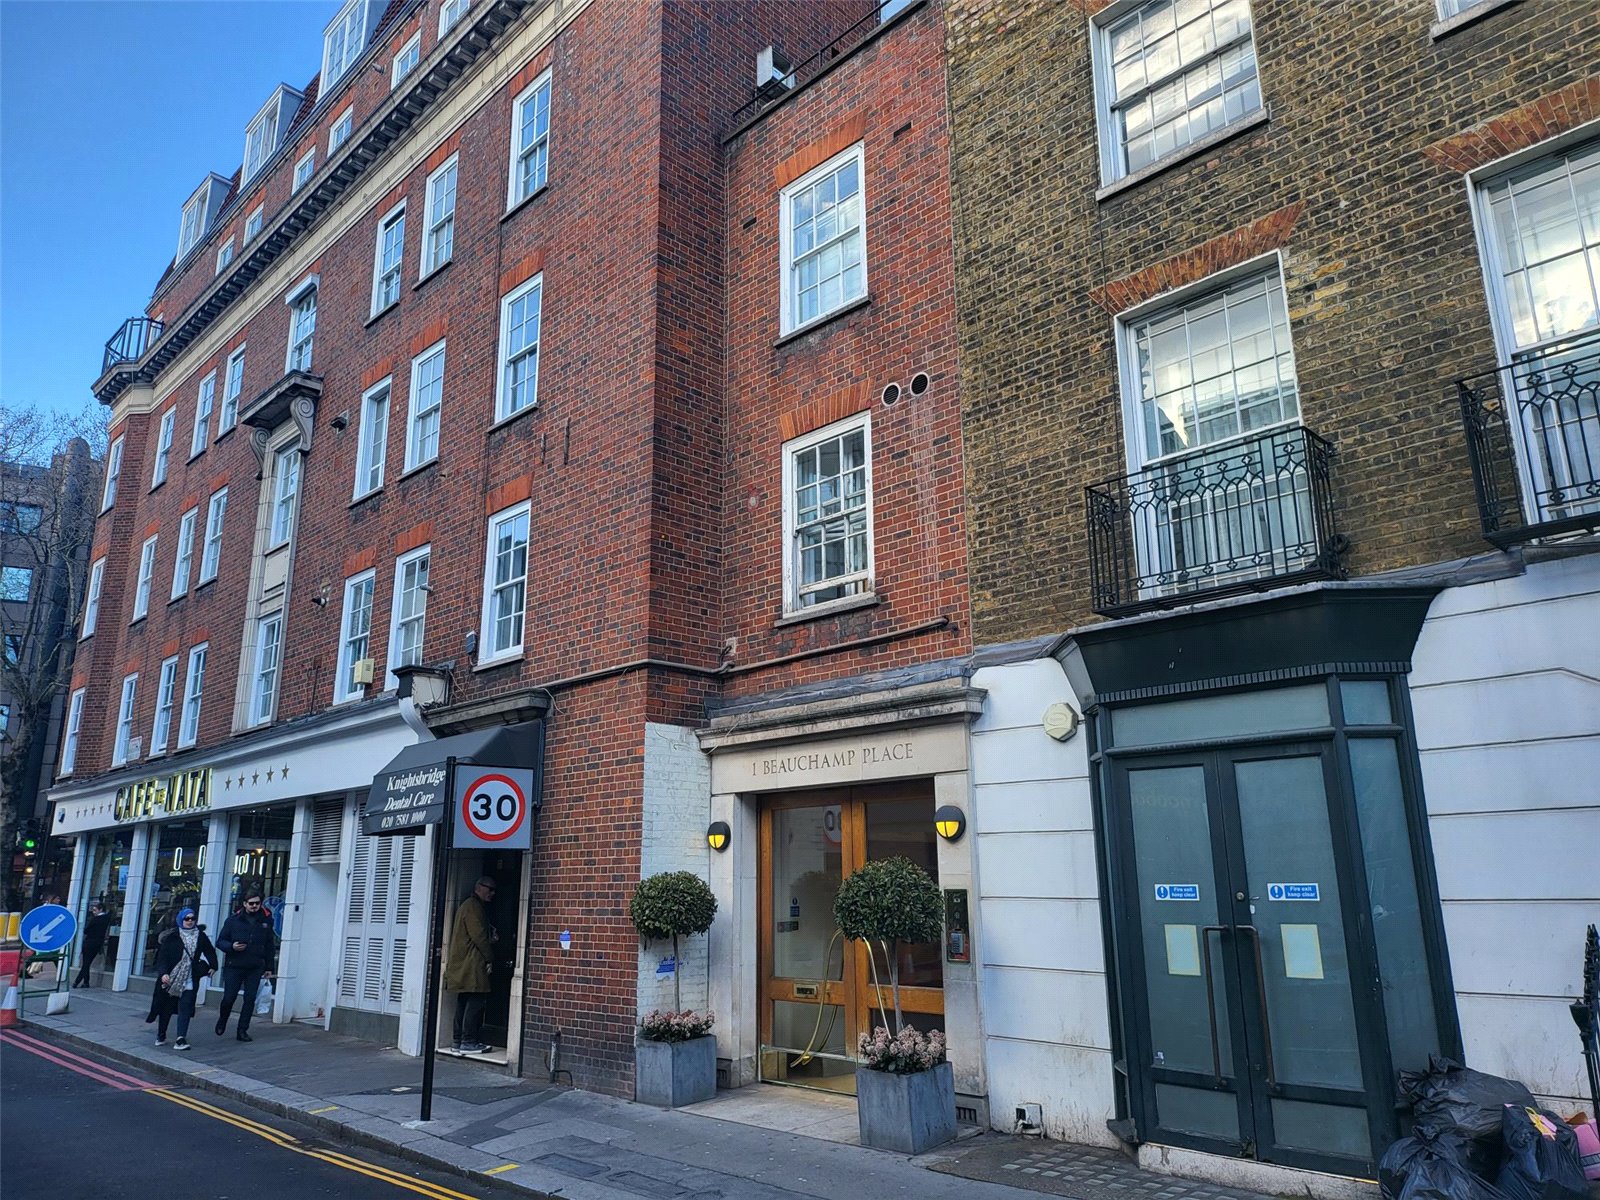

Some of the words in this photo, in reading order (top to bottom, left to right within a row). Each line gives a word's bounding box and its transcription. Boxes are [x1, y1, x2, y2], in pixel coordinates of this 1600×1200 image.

[751, 762, 757, 776] 1
[762, 749, 855, 775] BEAUCHAMP
[863, 742, 914, 764] PLACE
[386, 767, 446, 792] Knightsbridge
[114, 780, 158, 821] CAFE
[164, 768, 212, 814] NATA
[383, 794, 413, 812] Dental
[413, 791, 435, 807] Care
[472, 793, 517, 821] 30
[381, 815, 394, 829] 020
[395, 813, 409, 828] 7581
[411, 810, 427, 825] 1000
